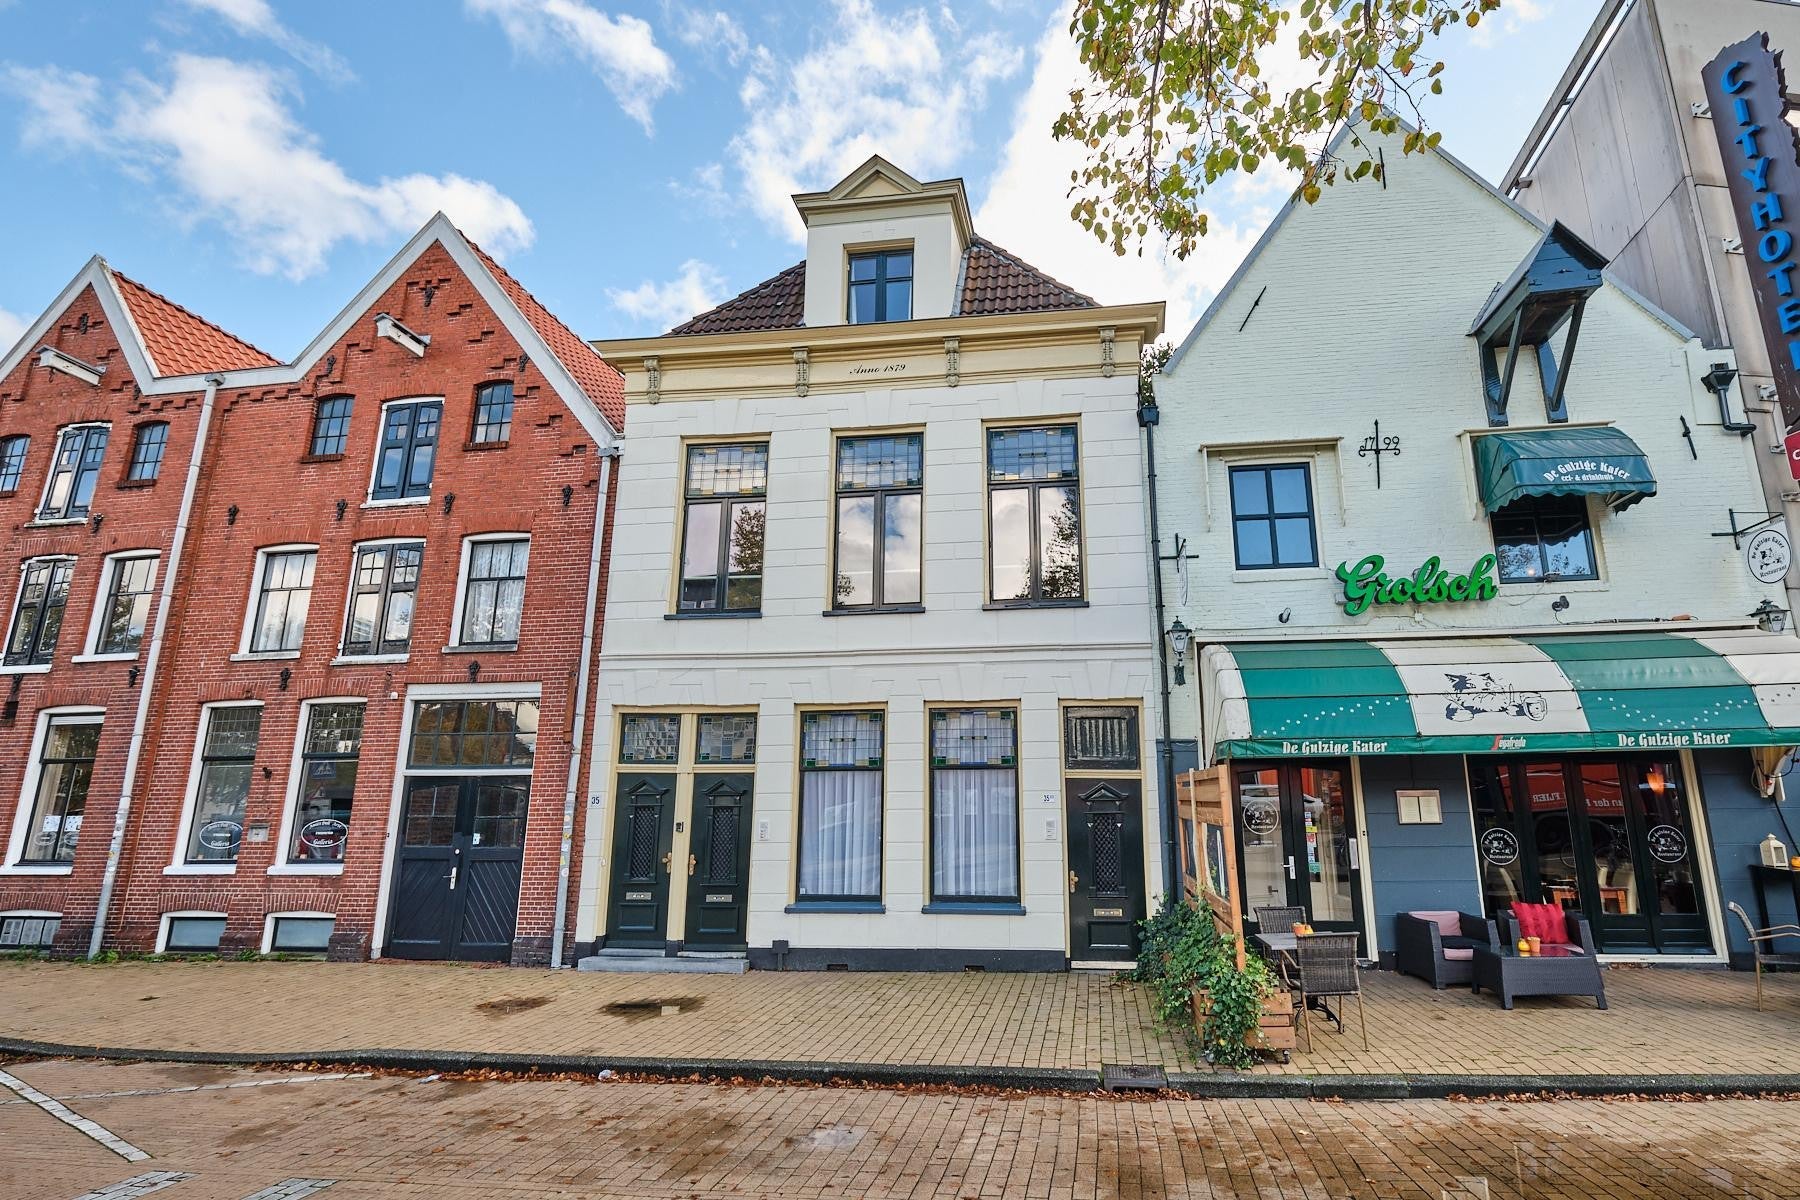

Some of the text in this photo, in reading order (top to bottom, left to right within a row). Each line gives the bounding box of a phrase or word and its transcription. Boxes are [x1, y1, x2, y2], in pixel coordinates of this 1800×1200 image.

[849, 364, 906, 374] Anno 1879
[1543, 460, 1631, 482] De Gulzige Kater
[1334, 553, 1498, 616] Grolsch
[1282, 740, 1388, 755] De Gulzige Kater
[1617, 731, 1731, 748] De Gulzige Kater
[591, 796, 600, 805] 35
